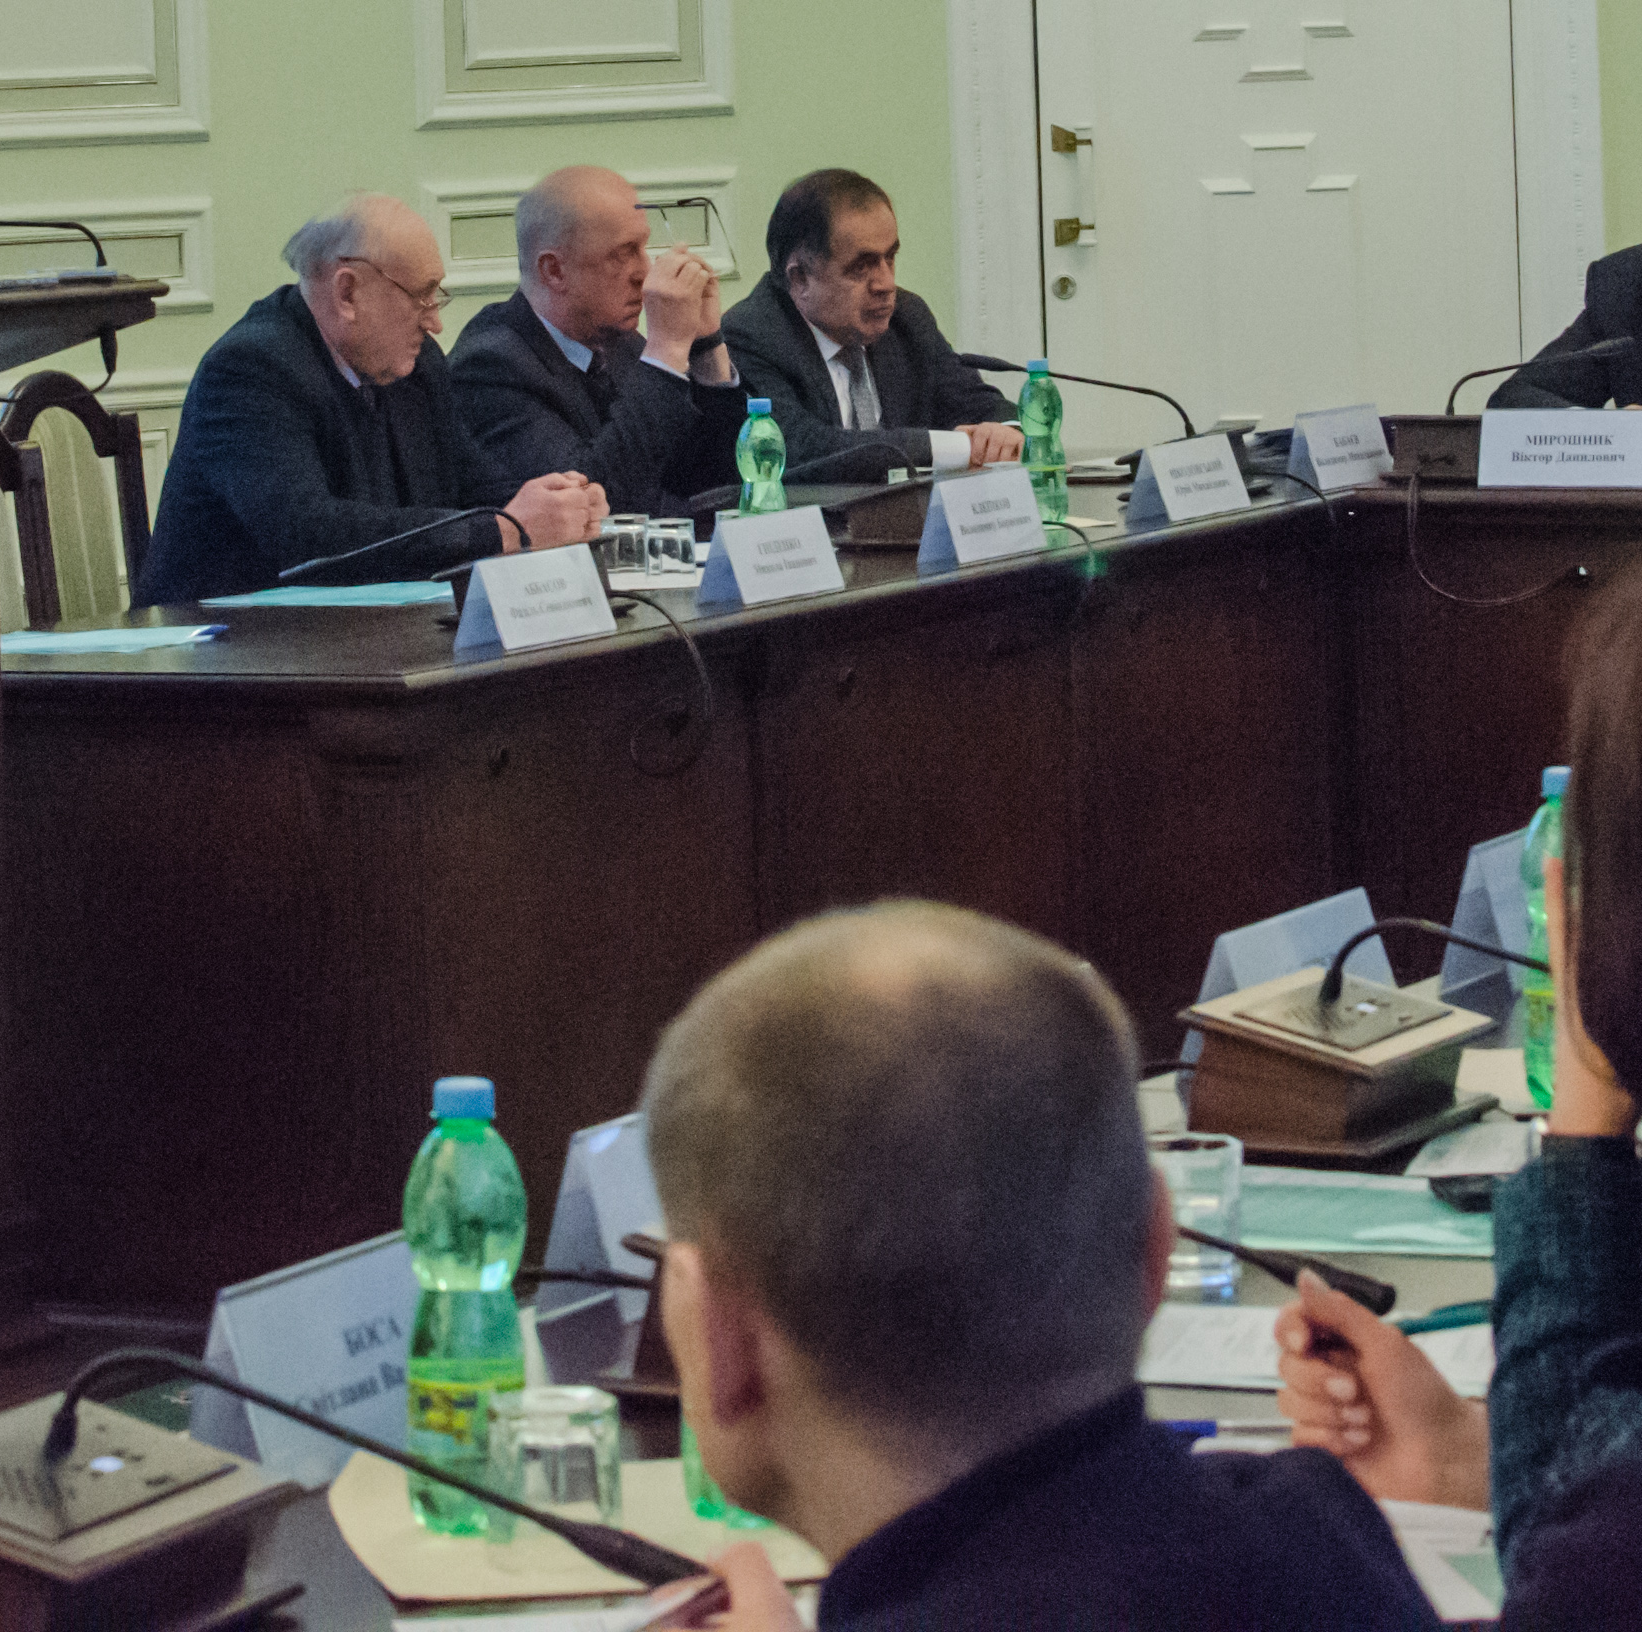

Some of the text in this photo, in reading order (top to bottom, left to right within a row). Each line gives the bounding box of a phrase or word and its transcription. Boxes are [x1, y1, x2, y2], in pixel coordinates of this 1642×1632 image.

[1525, 434, 1615, 446] МИРОШНИК
[1511, 451, 1625, 465] Віктор Данилович
